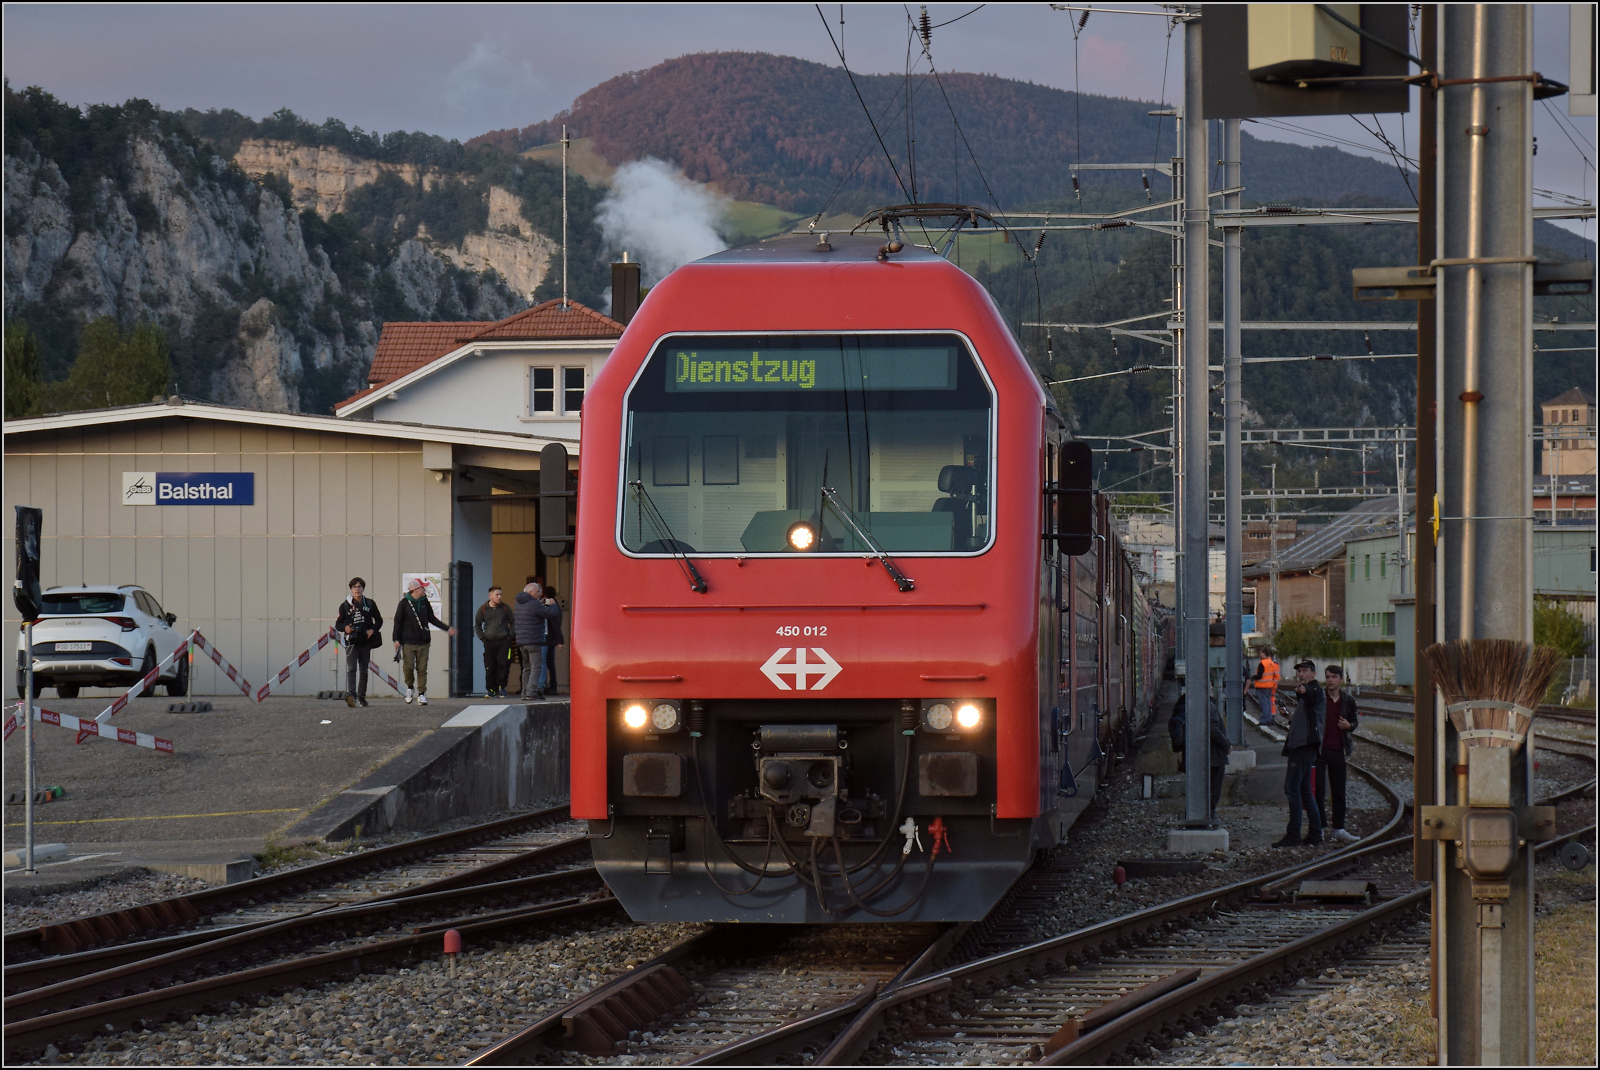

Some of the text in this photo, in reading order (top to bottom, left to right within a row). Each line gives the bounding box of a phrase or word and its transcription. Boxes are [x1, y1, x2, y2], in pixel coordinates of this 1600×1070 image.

[676, 351, 816, 389] Dienstzug
[158, 482, 233, 500] Balsthal
[775, 625, 828, 637] 450 012
